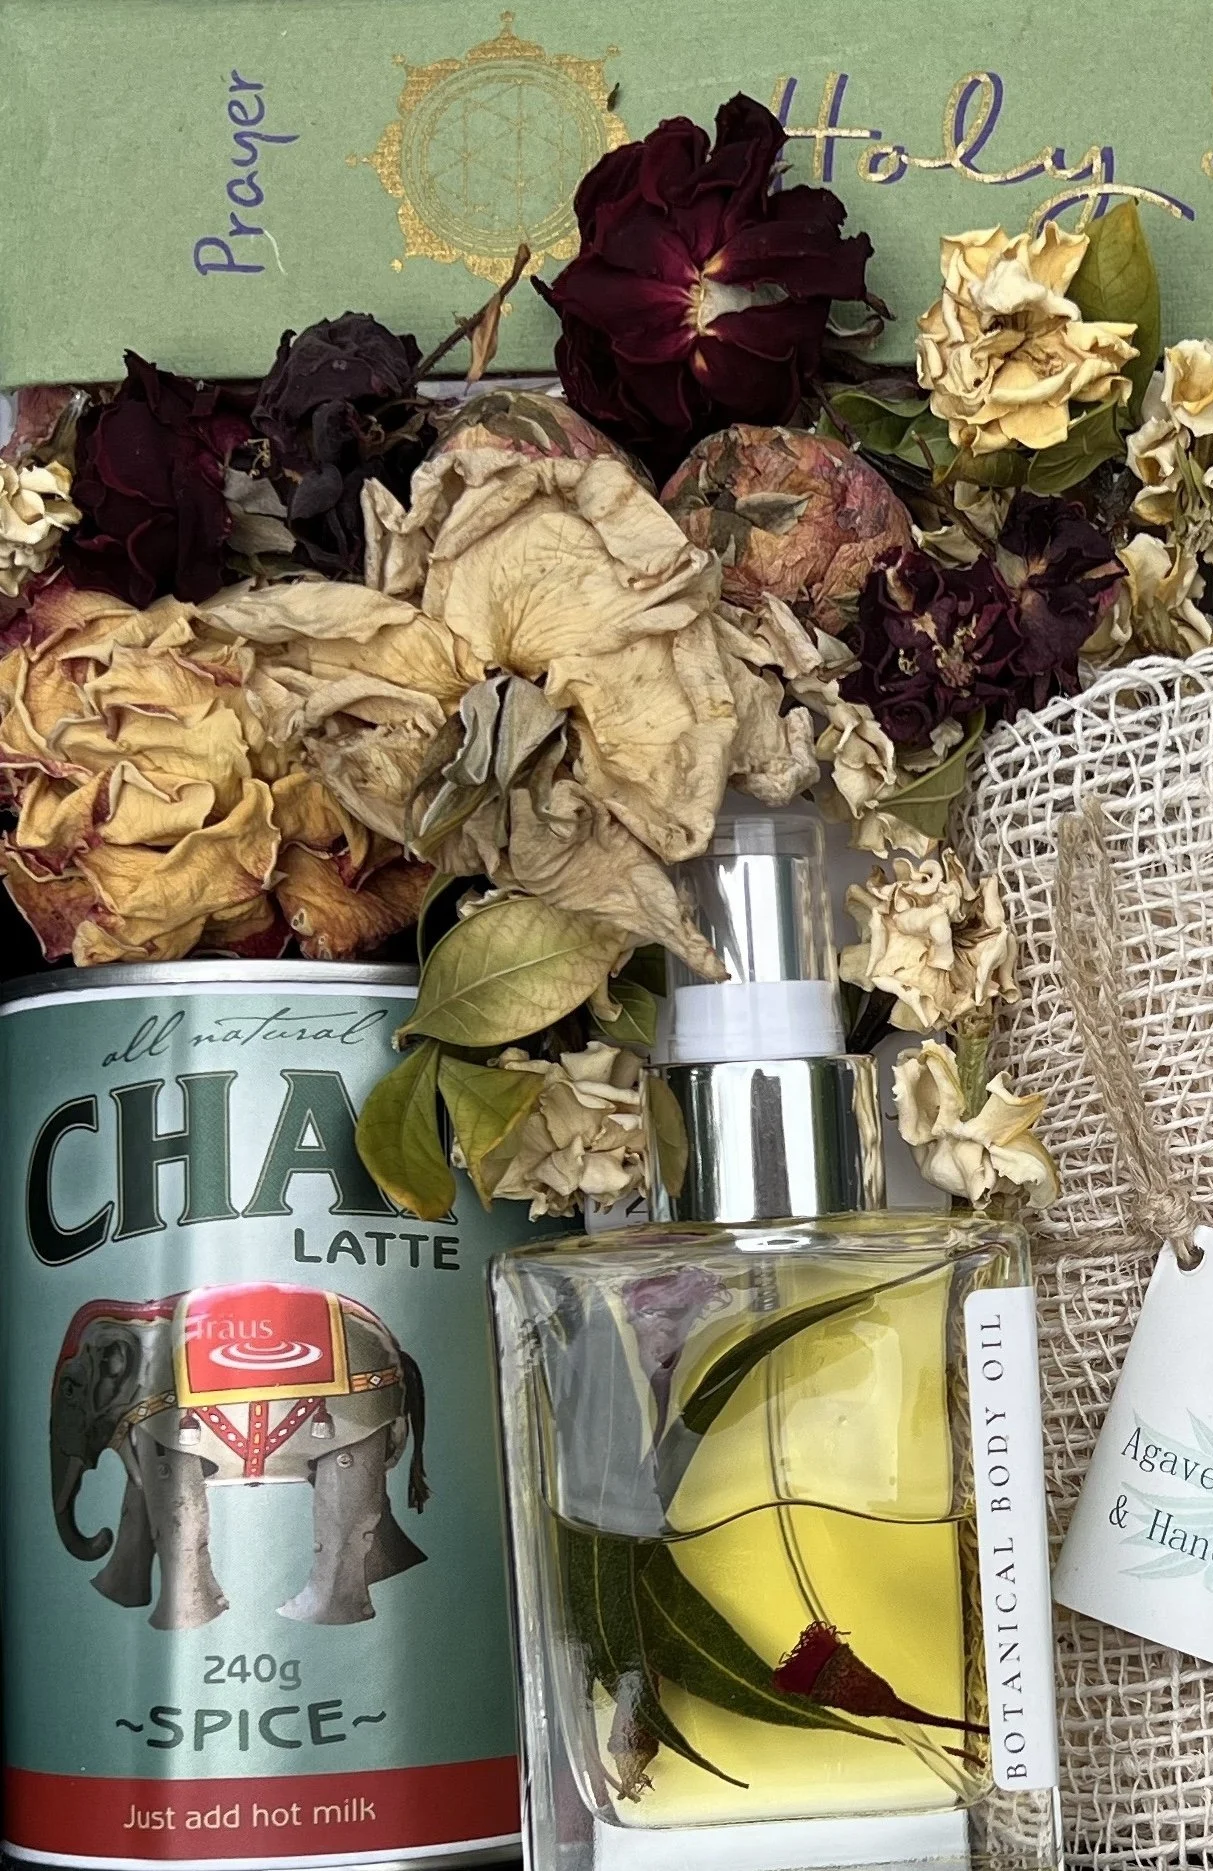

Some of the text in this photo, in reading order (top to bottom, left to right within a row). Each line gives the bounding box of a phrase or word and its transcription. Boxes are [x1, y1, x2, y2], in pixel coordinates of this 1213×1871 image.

[193, 69, 299, 275] Prayer
[767, 71, 1195, 238] Holy
[102, 1007, 388, 1067] all natural
[26, 1068, 458, 1268] CHA
[295, 1228, 460, 1271] LATTE
[1109, 1493, 1129, 1529] &
[980, 1312, 1028, 1781] BOTANICAL BODY OIL
[203, 1653, 302, 1691] 240g
[123, 1797, 377, 1830] Just add hot milk
